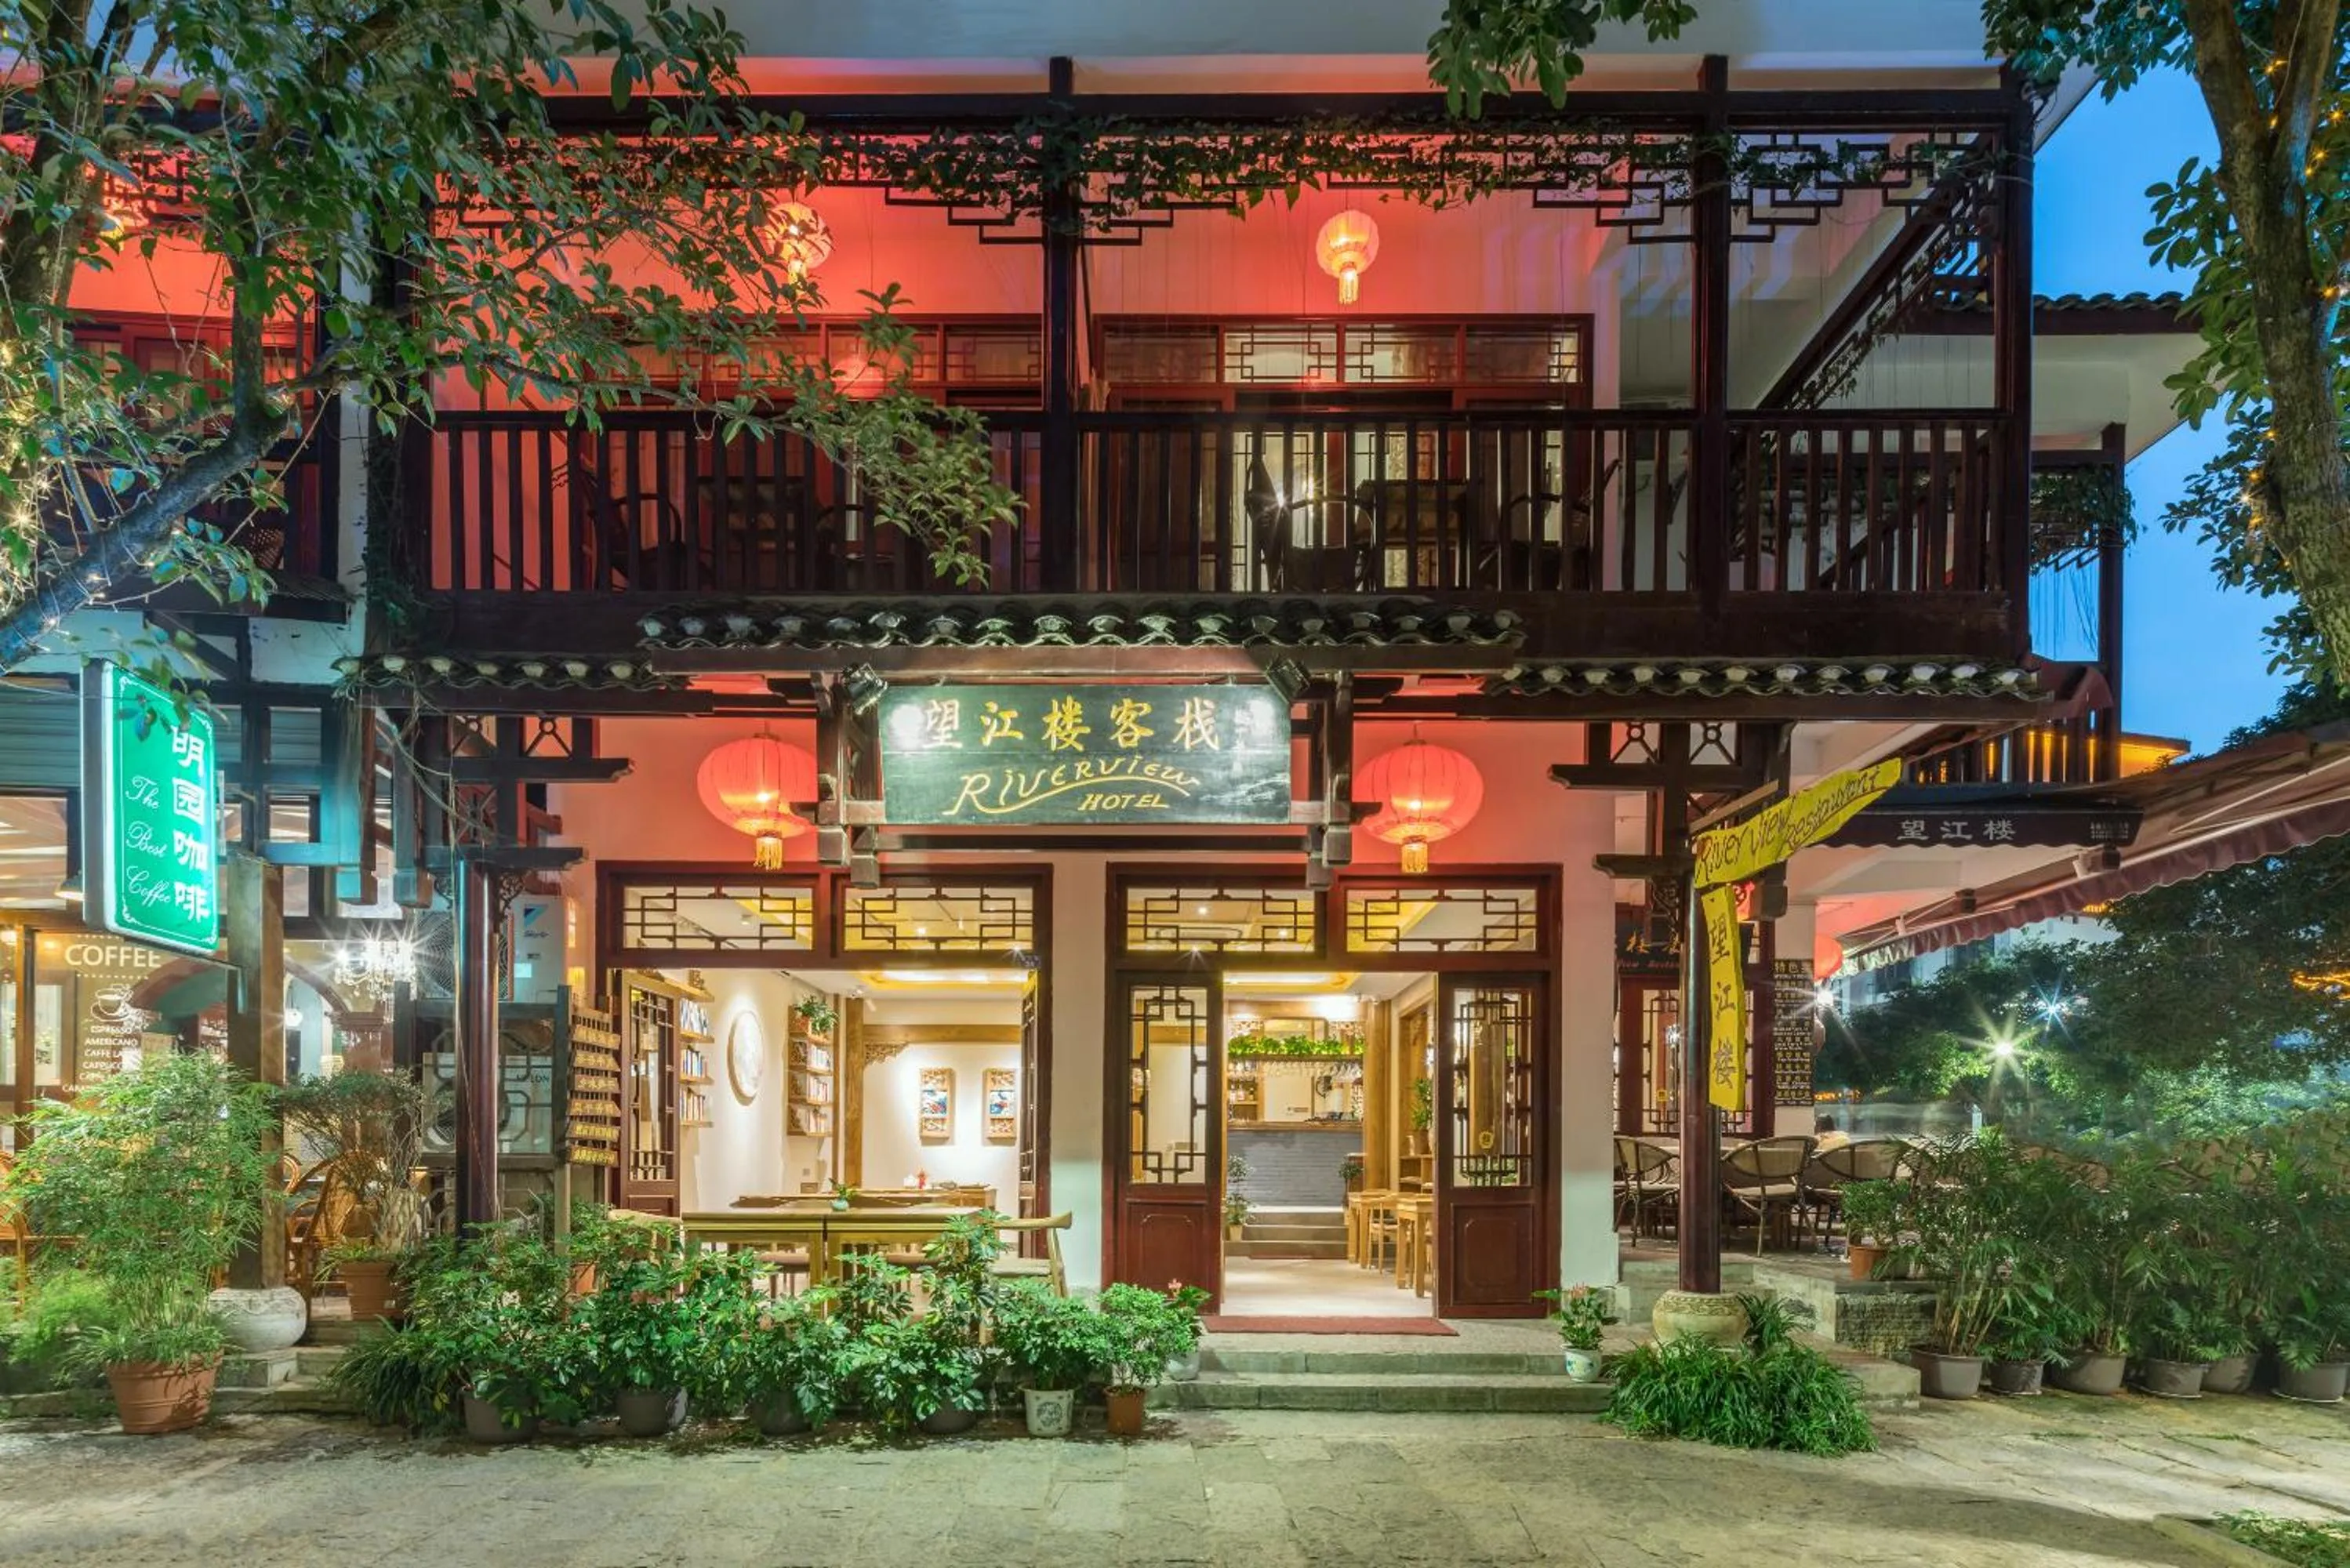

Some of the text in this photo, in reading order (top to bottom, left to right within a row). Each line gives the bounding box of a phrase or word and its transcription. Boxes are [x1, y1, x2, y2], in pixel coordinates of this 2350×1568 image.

[922, 695, 1219, 752] 望江楼客栈
[125, 775, 160, 809] The
[1078, 793, 1169, 811] HOTEL
[125, 820, 168, 858] Best
[171, 725, 209, 923] 明园咖啡
[1896, 819, 2017, 841] 望江楼
[125, 865, 171, 908] Coffee
[64, 943, 162, 968] COFFEE
[1709, 913, 1736, 1089] 望江楼
[84, 1037, 139, 1047] AMERICANO
